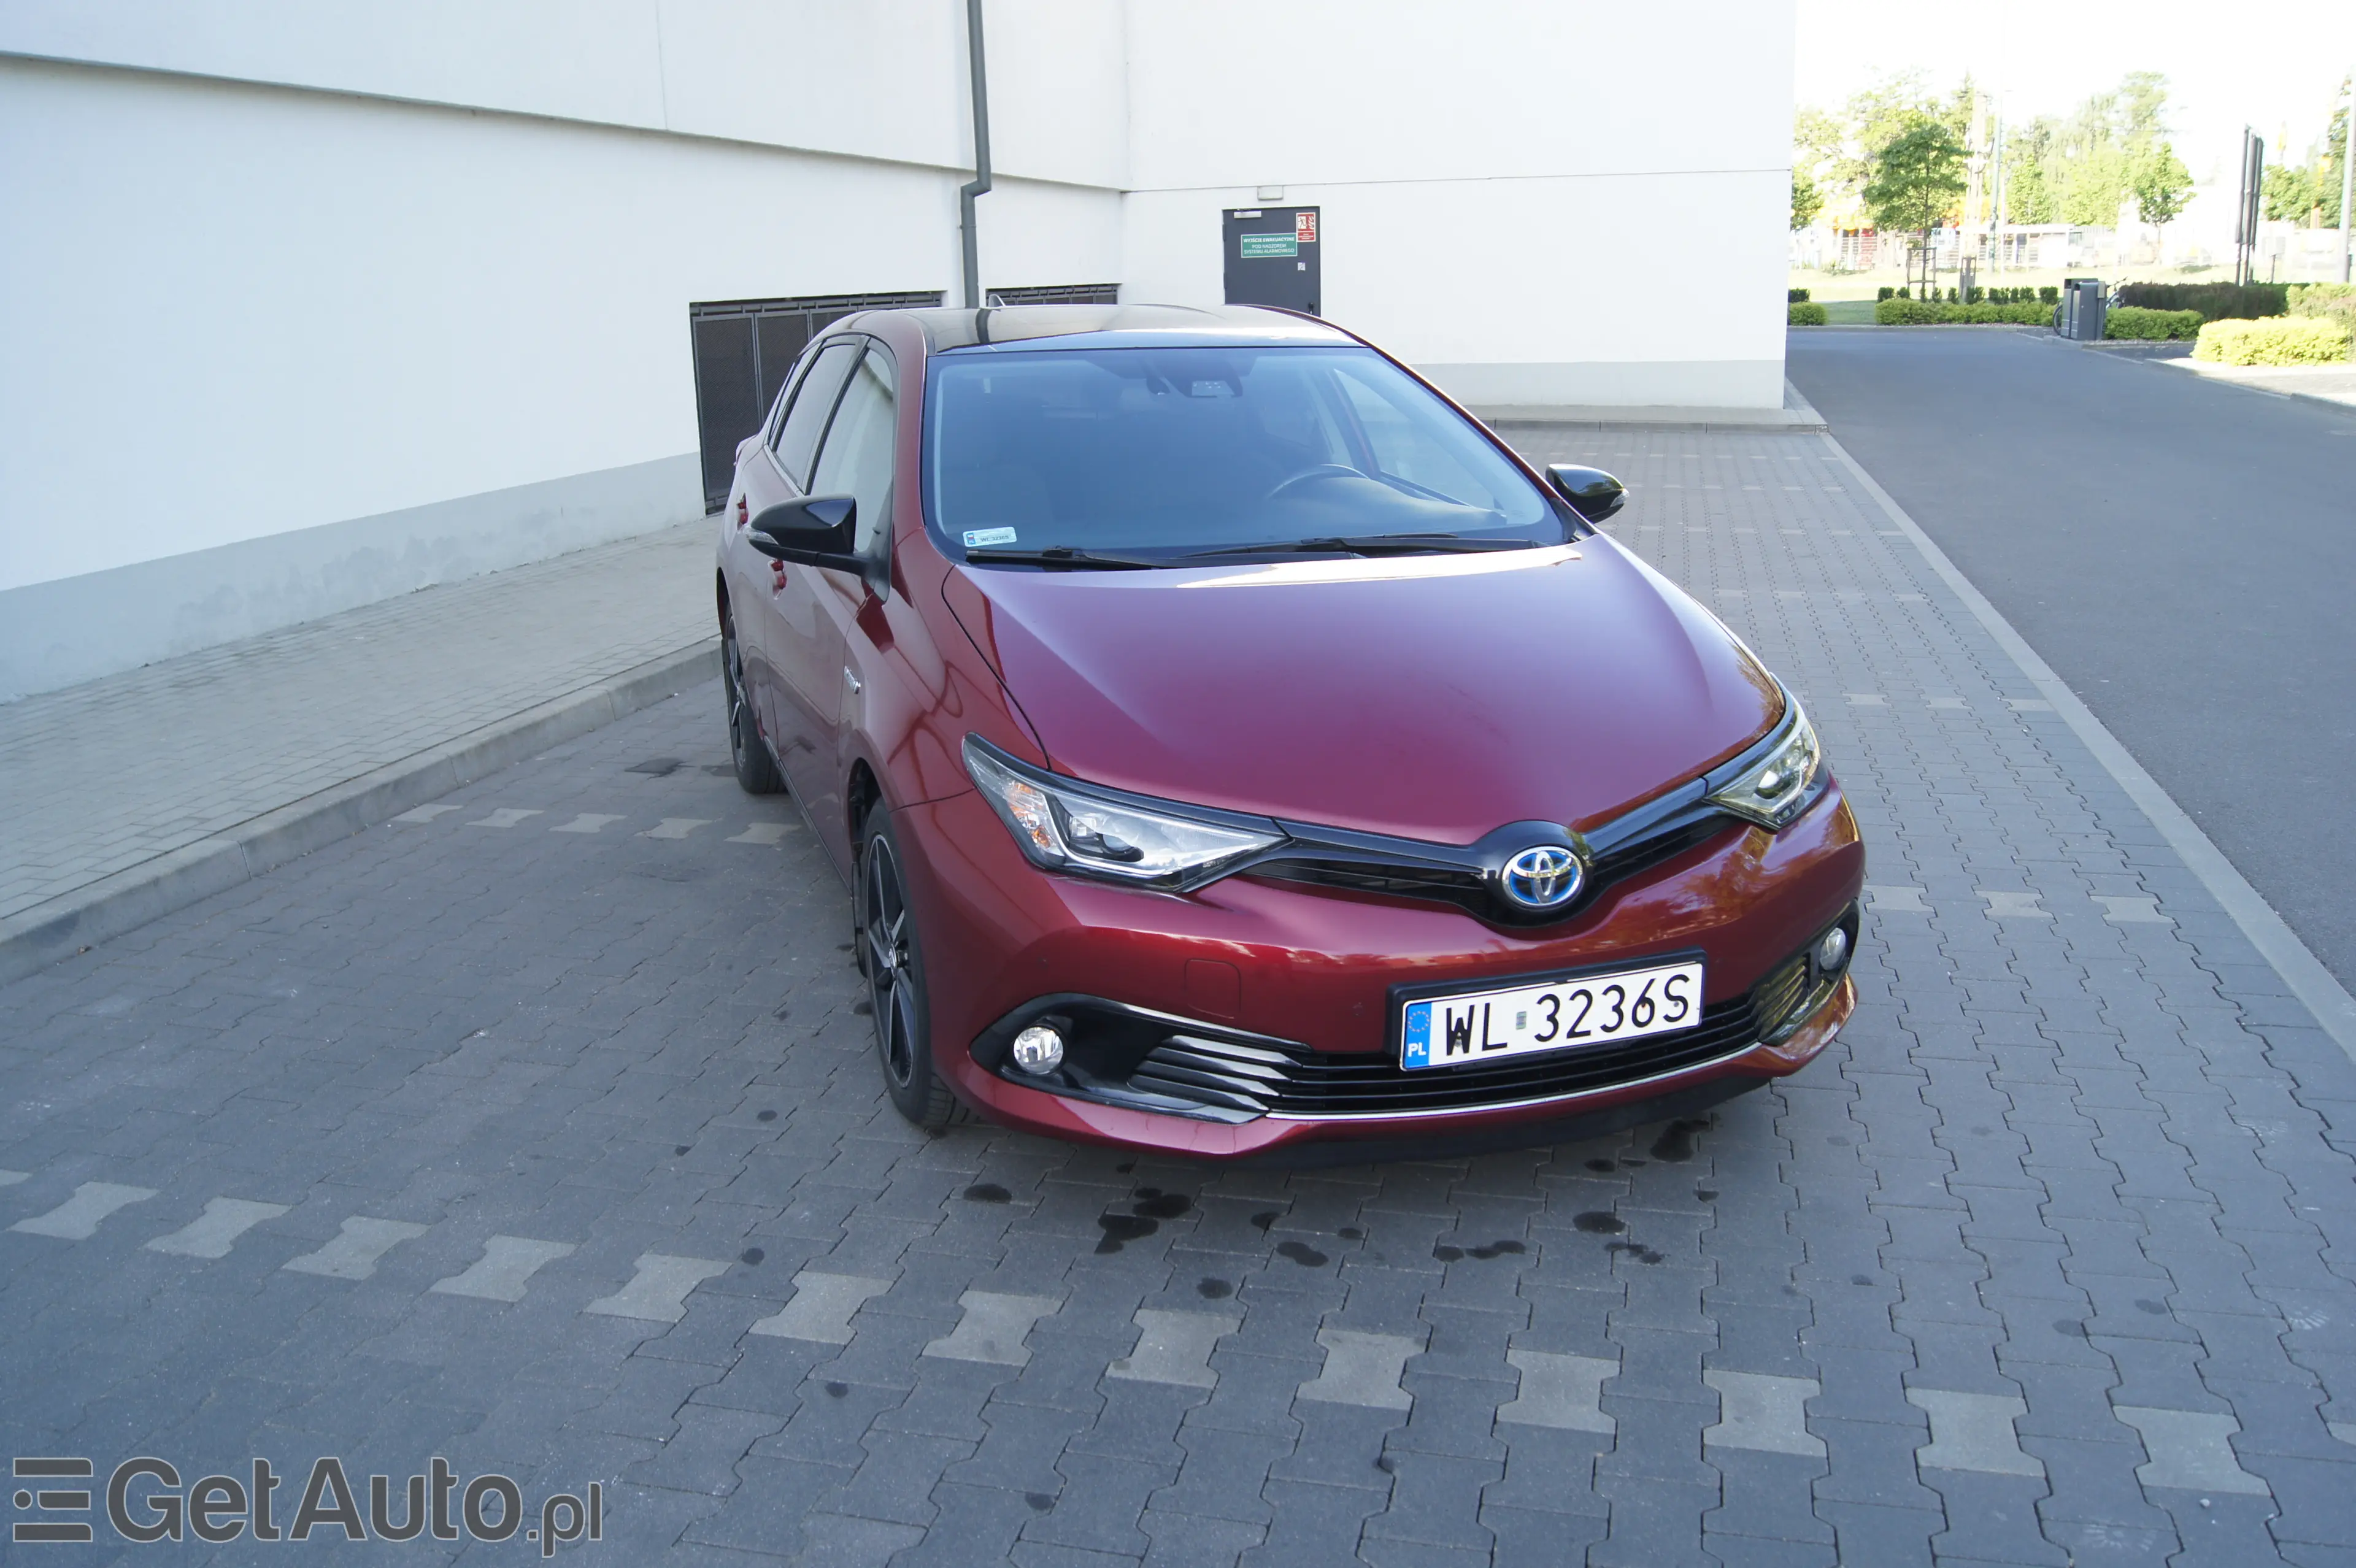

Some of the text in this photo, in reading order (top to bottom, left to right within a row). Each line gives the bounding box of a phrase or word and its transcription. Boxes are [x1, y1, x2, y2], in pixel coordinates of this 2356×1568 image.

[1446, 974, 1690, 1056] WL 3236S
[1407, 1042, 1426, 1057] PL
